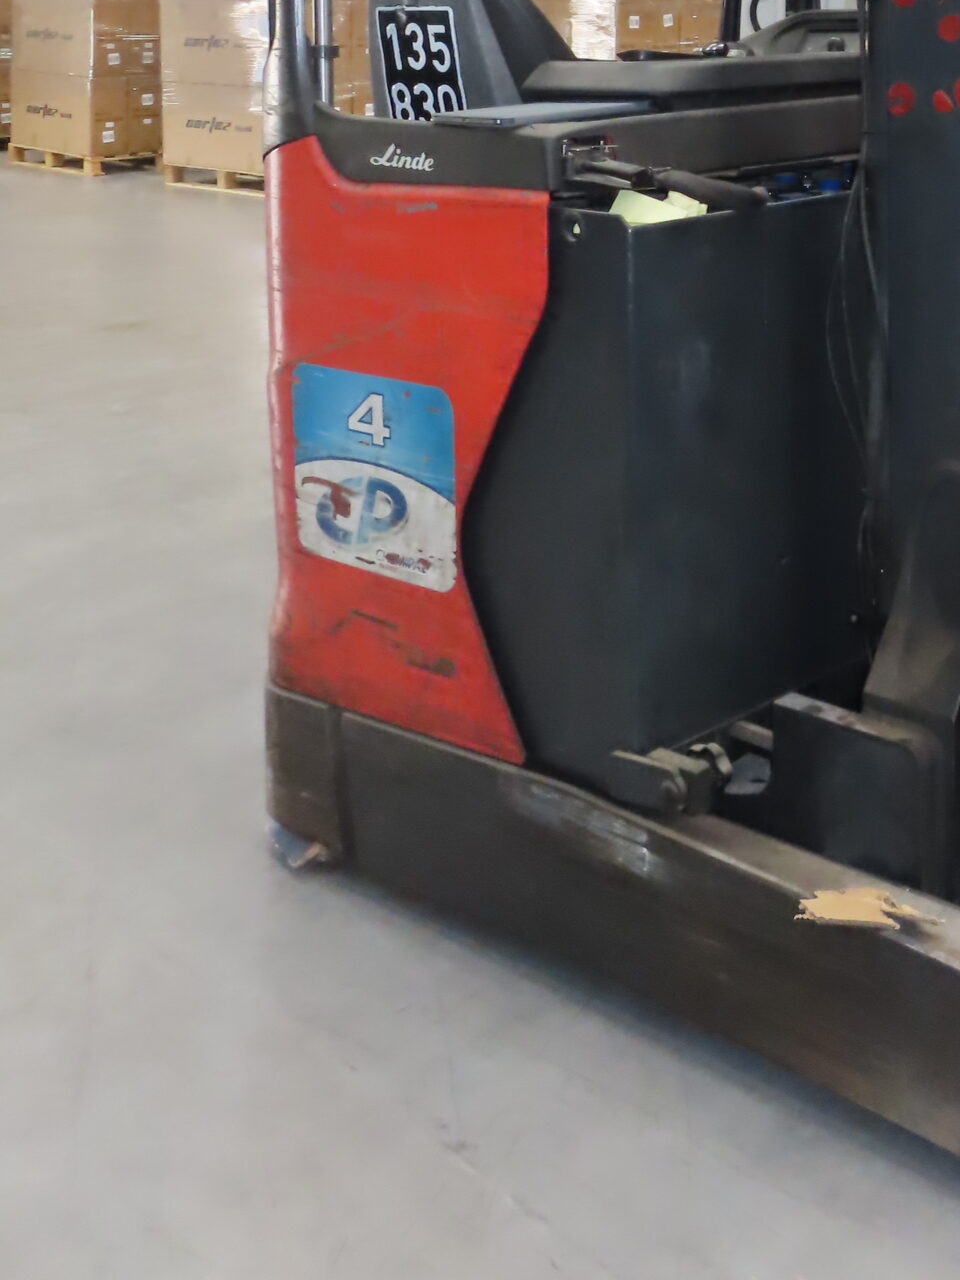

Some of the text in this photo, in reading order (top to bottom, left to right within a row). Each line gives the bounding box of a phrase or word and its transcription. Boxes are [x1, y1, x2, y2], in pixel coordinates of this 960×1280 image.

[386, 22, 451, 73] 135
[370, 143, 434, 171] Linde
[348, 392, 392, 448] 4
